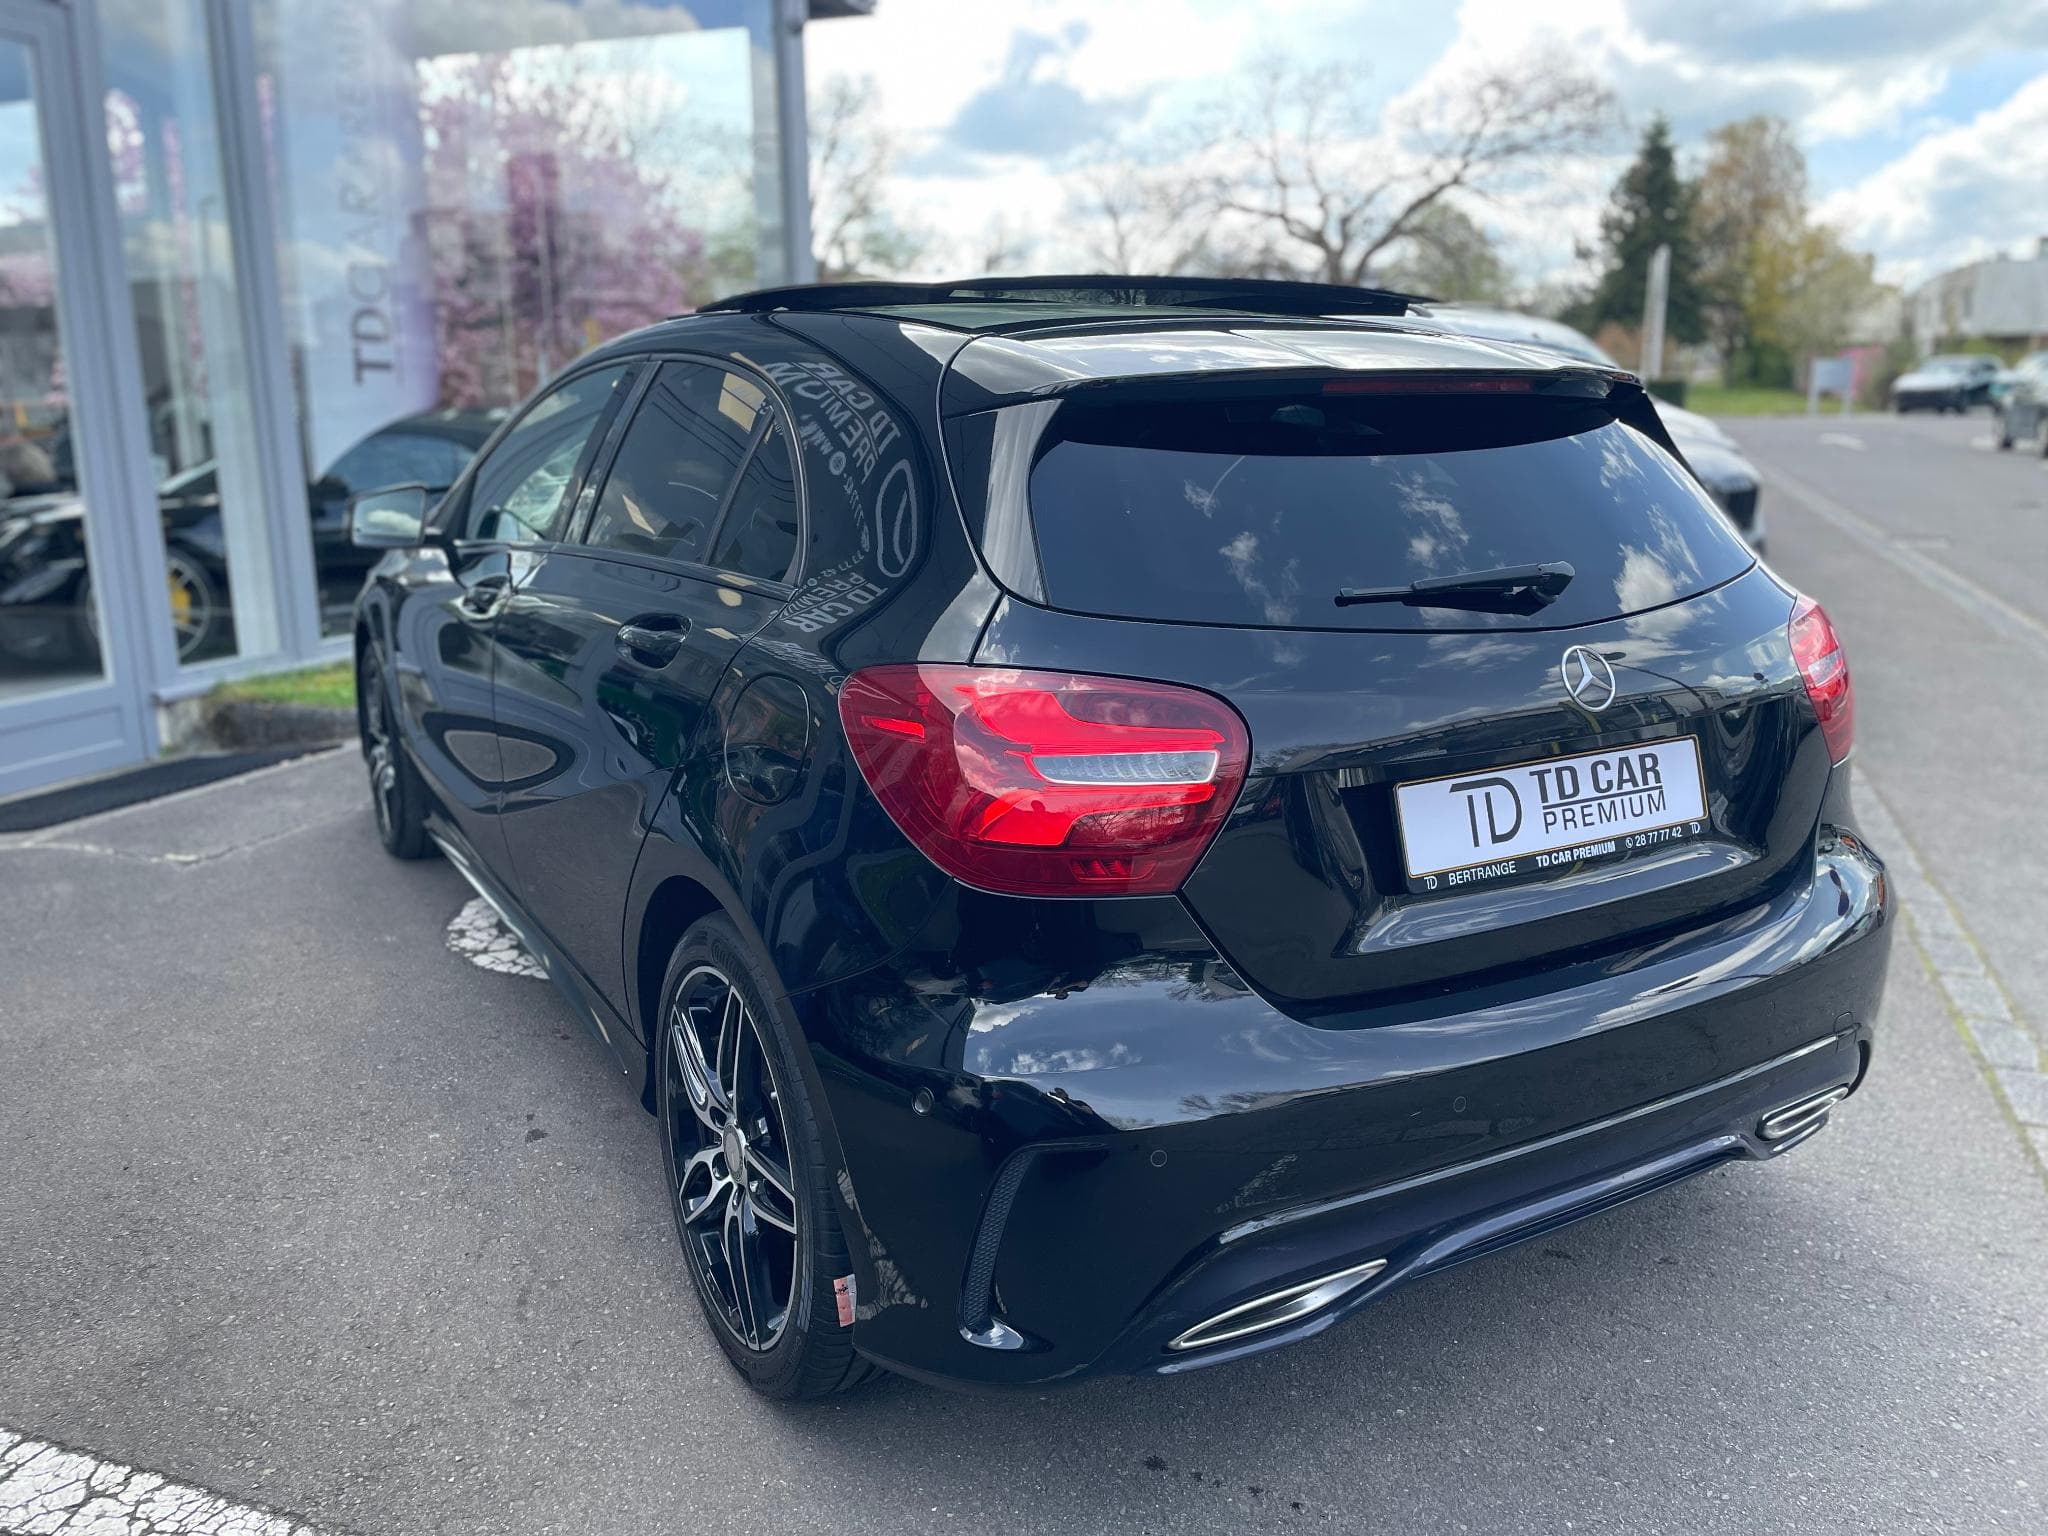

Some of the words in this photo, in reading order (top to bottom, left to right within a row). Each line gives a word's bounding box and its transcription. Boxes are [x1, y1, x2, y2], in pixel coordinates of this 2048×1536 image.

[1529, 765, 1580, 804] TD
[1590, 752, 1663, 792] CAR
[1450, 776, 1523, 848] TD
[1542, 789, 1667, 835] PREMIUM
[1448, 860, 1517, 886] BERTRANGE
[1535, 854, 1550, 868] TD
[1551, 850, 1572, 865] CAR
[1572, 840, 1616, 861] PREMIUM
